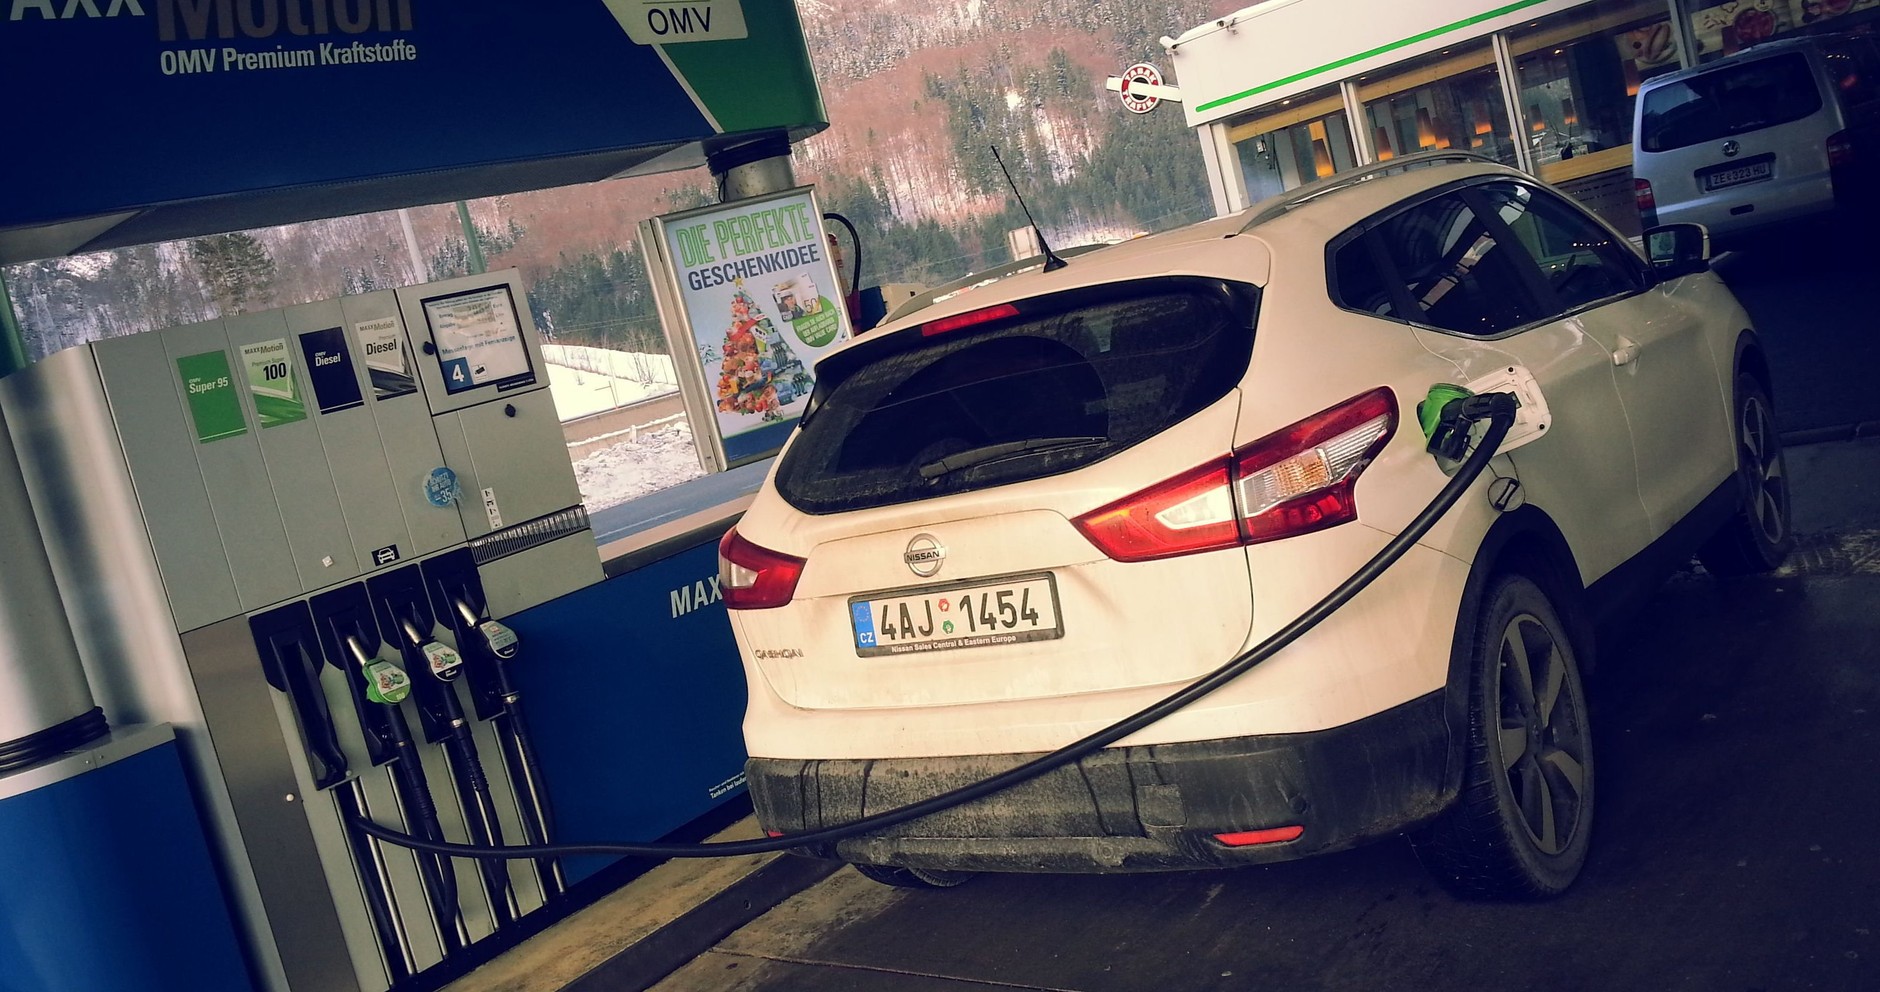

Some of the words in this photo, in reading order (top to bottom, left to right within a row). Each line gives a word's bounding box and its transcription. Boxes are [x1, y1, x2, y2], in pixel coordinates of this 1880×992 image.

[647, 7, 711, 36] OMV
[160, 48, 216, 76] OMV
[222, 45, 315, 71] Premium
[319, 39, 417, 65] Kraftstoffe
[1125, 67, 1157, 84] TABAK
[1122, 89, 1154, 111] TRAFIK
[1732, 168, 1751, 181] 323
[675, 223, 715, 268] DIE
[713, 202, 815, 260] PERFEKTE
[688, 243, 820, 291] GESCHENKIDEE
[366, 339, 397, 355] Diesel
[315, 352, 341, 367] Diesel
[263, 362, 287, 381] 100
[452, 364, 465, 382] 4
[189, 381, 216, 394] Super
[217, 376, 229, 388] 95
[906, 551, 940, 562] NISSAN
[859, 632, 875, 644] CZ
[880, 599, 935, 641] 4AJ
[959, 587, 1039, 633] 1454
[891, 645, 914, 653] Nissan
[914, 643, 932, 651] Sales
[932, 640, 957, 649] Central
[957, 639, 964, 647] &
[964, 637, 991, 646] Eastern
[991, 634, 1017, 643] Europe
